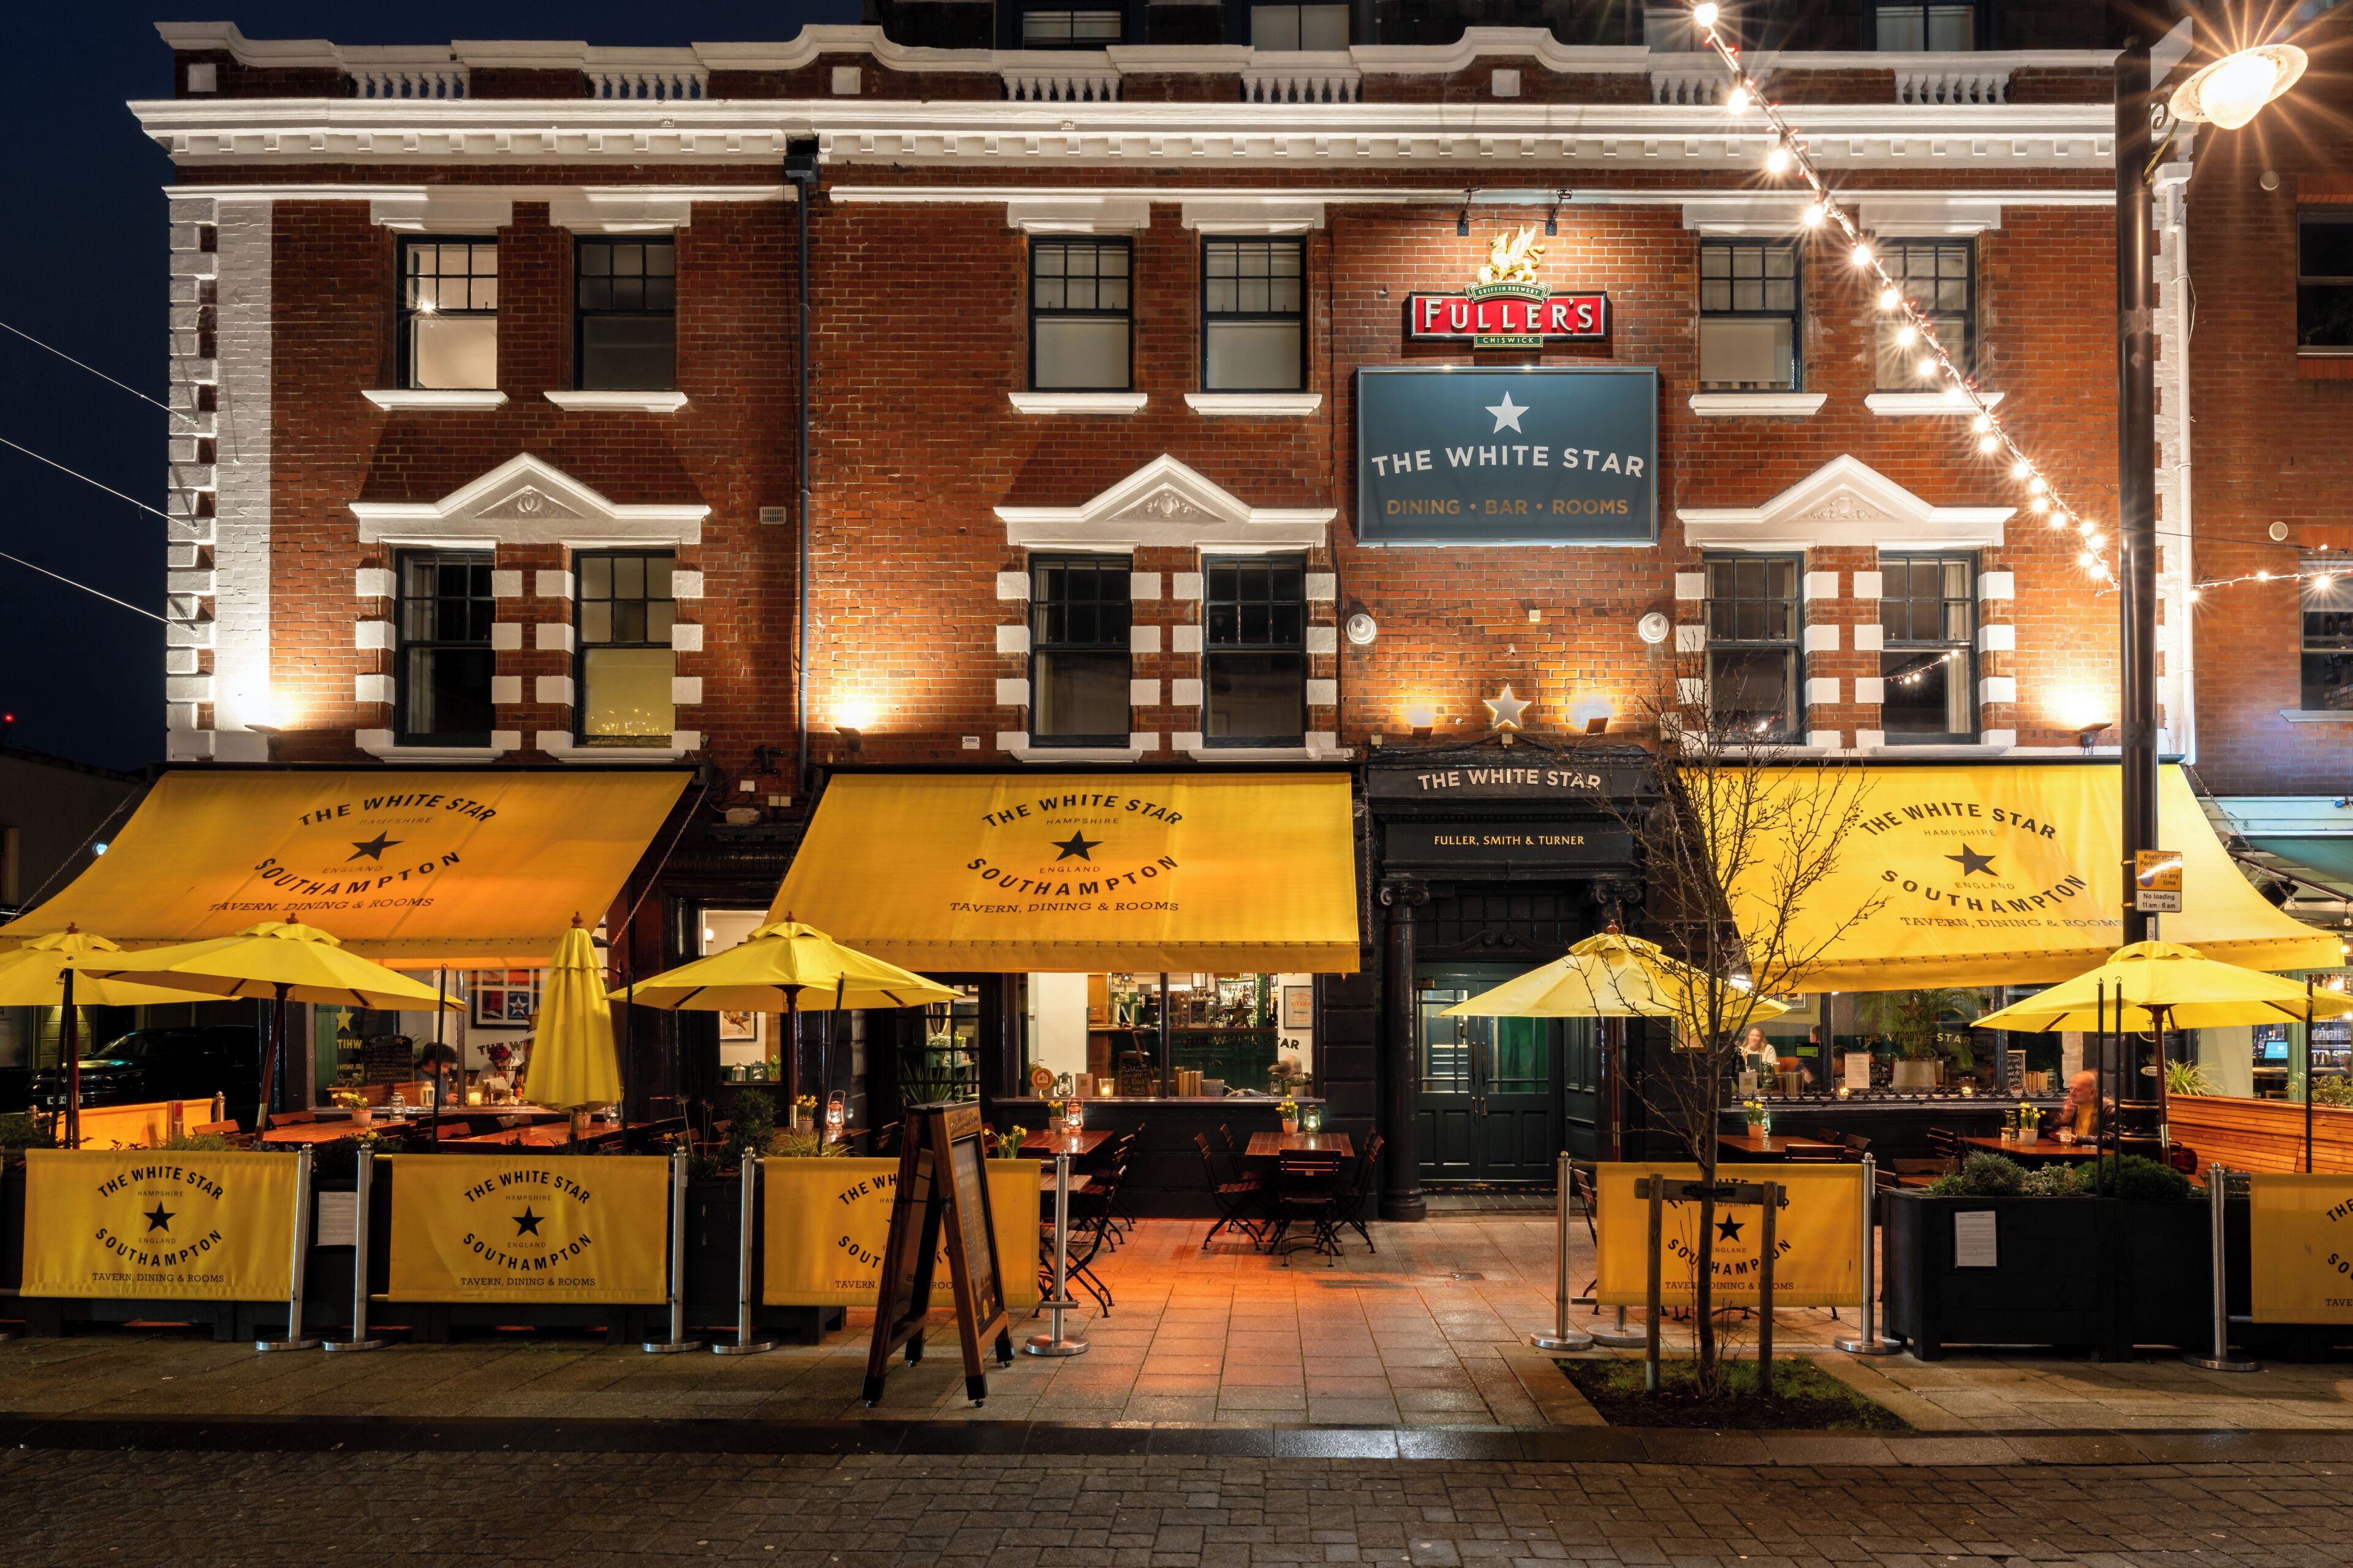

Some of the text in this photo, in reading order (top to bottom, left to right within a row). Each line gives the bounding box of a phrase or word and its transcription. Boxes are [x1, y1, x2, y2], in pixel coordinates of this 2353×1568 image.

[1478, 286, 1540, 295] GRIFFIN BREWERY
[1424, 297, 1594, 332] FULLER'S
[1482, 335, 1535, 345] CHISWICK
[1371, 445, 1645, 478] THE WHITE STAR
[1387, 499, 1629, 516] DINING BAR ROOMS
[1417, 768, 1601, 791] THE WHITE STAR
[298, 793, 498, 827] THE WHITE STAR
[982, 793, 1183, 828] THE WHITE STAR
[359, 817, 433, 825] HAMPSHIRE
[1046, 817, 1119, 825] HAMPSHIRE
[1859, 801, 2058, 840] THE WHITE STAR
[1924, 828, 1997, 837] HAMPSHIRE
[1434, 835, 1585, 847] FULLER, SMITH & TURNER
[254, 850, 462, 896] SOUTHAMPTON
[322, 865, 384, 874] ENGLAND
[967, 855, 1180, 896] SOUTHAMPTON
[1039, 865, 1101, 874] ENGLAND
[1881, 869, 2088, 914] SOUTHAMPTON
[1954, 882, 2015, 890] ENGLAND
[208, 897, 435, 913] TAVERN, DINING & ROOMS
[950, 900, 1179, 914] TAVERN, DINING & ROOMS
[1901, 917, 2123, 929] TAVERN, DINING & ROOMS
[1181, 1034, 1300, 1050] THE WHITE STAR
[1855, 1031, 1971, 1046] THE WHITE STAR
[477, 1043, 504, 1055] THE
[97, 1165, 224, 1201] THE WHITE STAR
[464, 1170, 591, 1205] THE WHITE STAR
[838, 1181, 870, 1206] THE
[2326, 1198, 2353, 1222] THE
[96, 1227, 222, 1268] SOUTHAMPTON
[463, 1232, 593, 1271] SOUTHAMPTON
[1668, 1238, 1792, 1275] SOUHAMPON
[93, 1273, 134, 1284] TAVERN,
[137, 1273, 174, 1282] DINING
[188, 1274, 225, 1282] ROOMS
[461, 1278, 596, 1287] TAVERN, DINING & ROOMS
[835, 1281, 877, 1290] TAVERN,
[2325, 1298, 2353, 1307] TAVE
